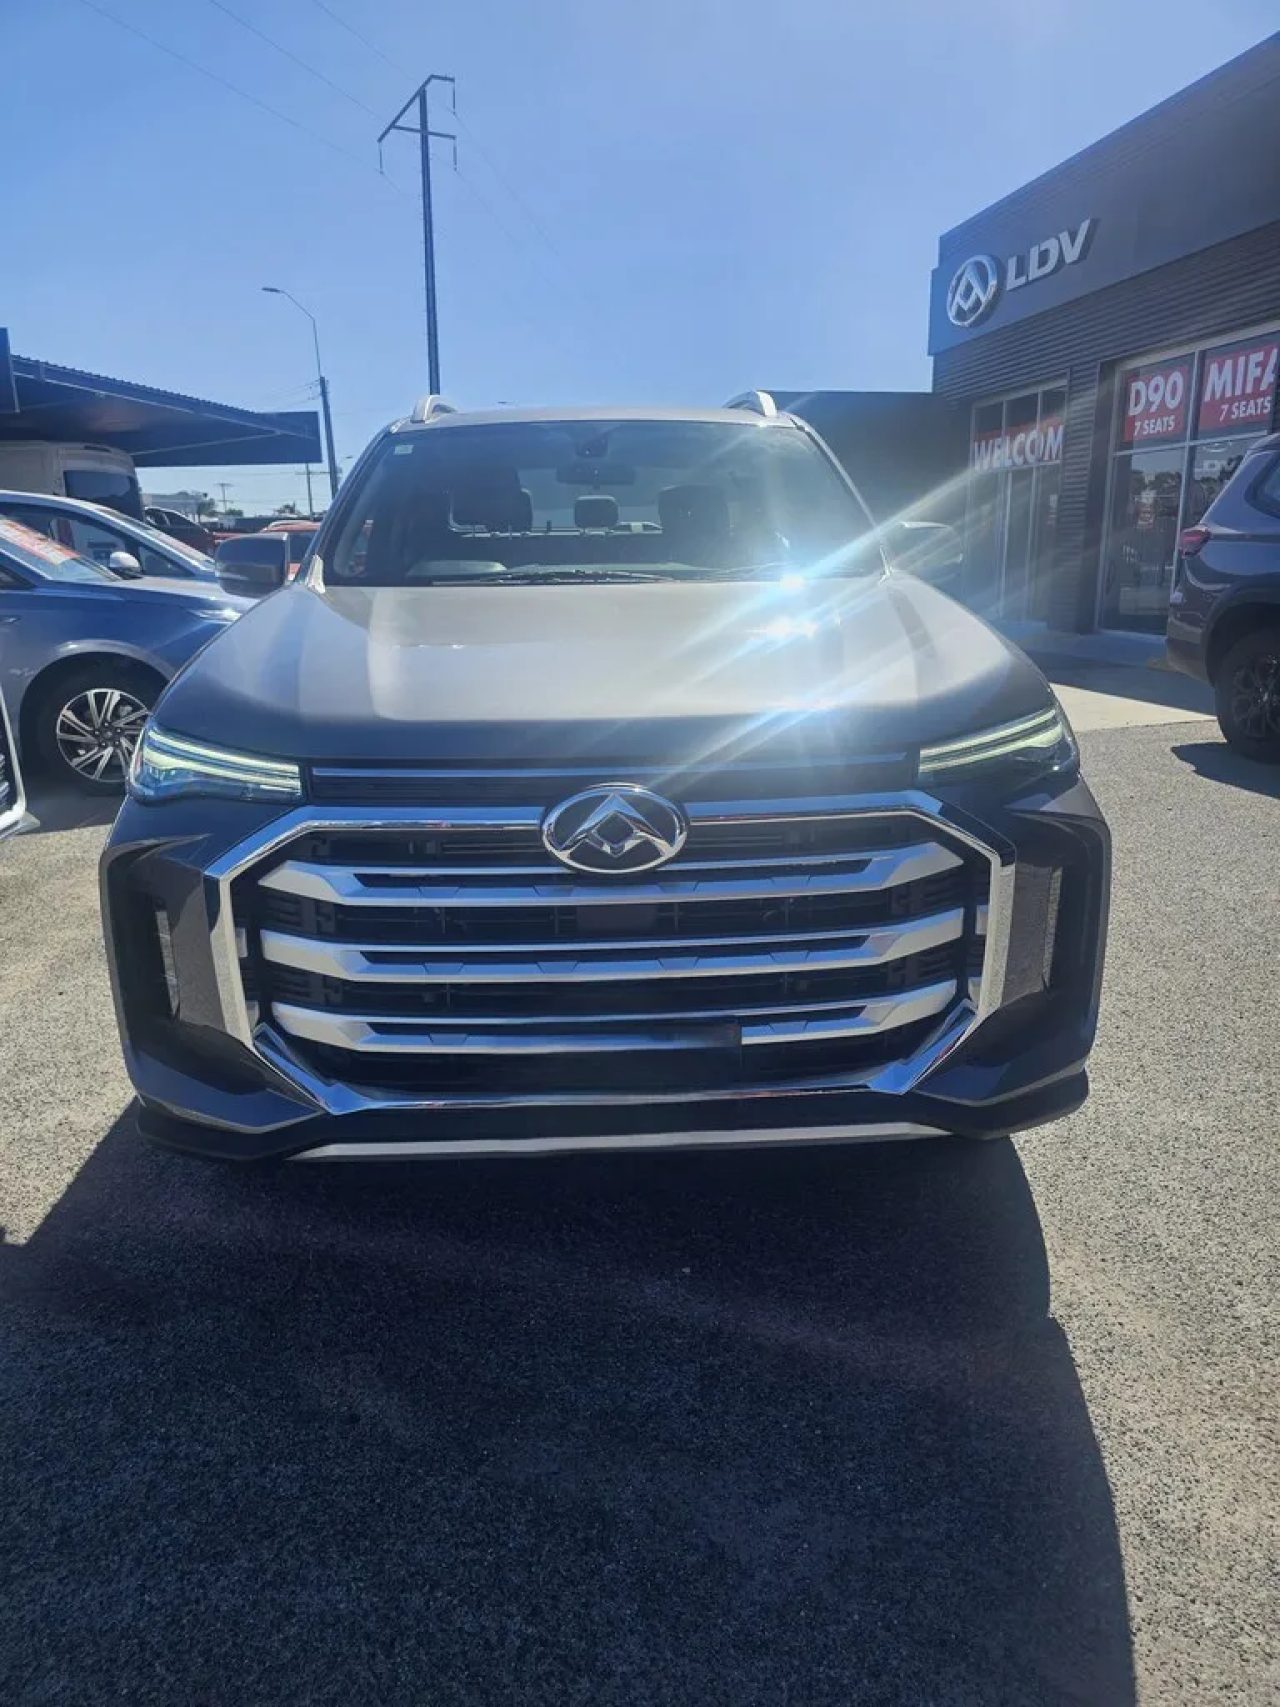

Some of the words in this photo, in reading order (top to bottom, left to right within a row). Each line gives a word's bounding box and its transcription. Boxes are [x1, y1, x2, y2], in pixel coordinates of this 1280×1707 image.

[1006, 216, 1091, 291] LDV
[1128, 370, 1184, 416] D90
[1219, 404, 1230, 422] 7
[1231, 396, 1272, 419] SEATS
[1134, 421, 1142, 436] 7
[1142, 415, 1176, 434] SEATS
